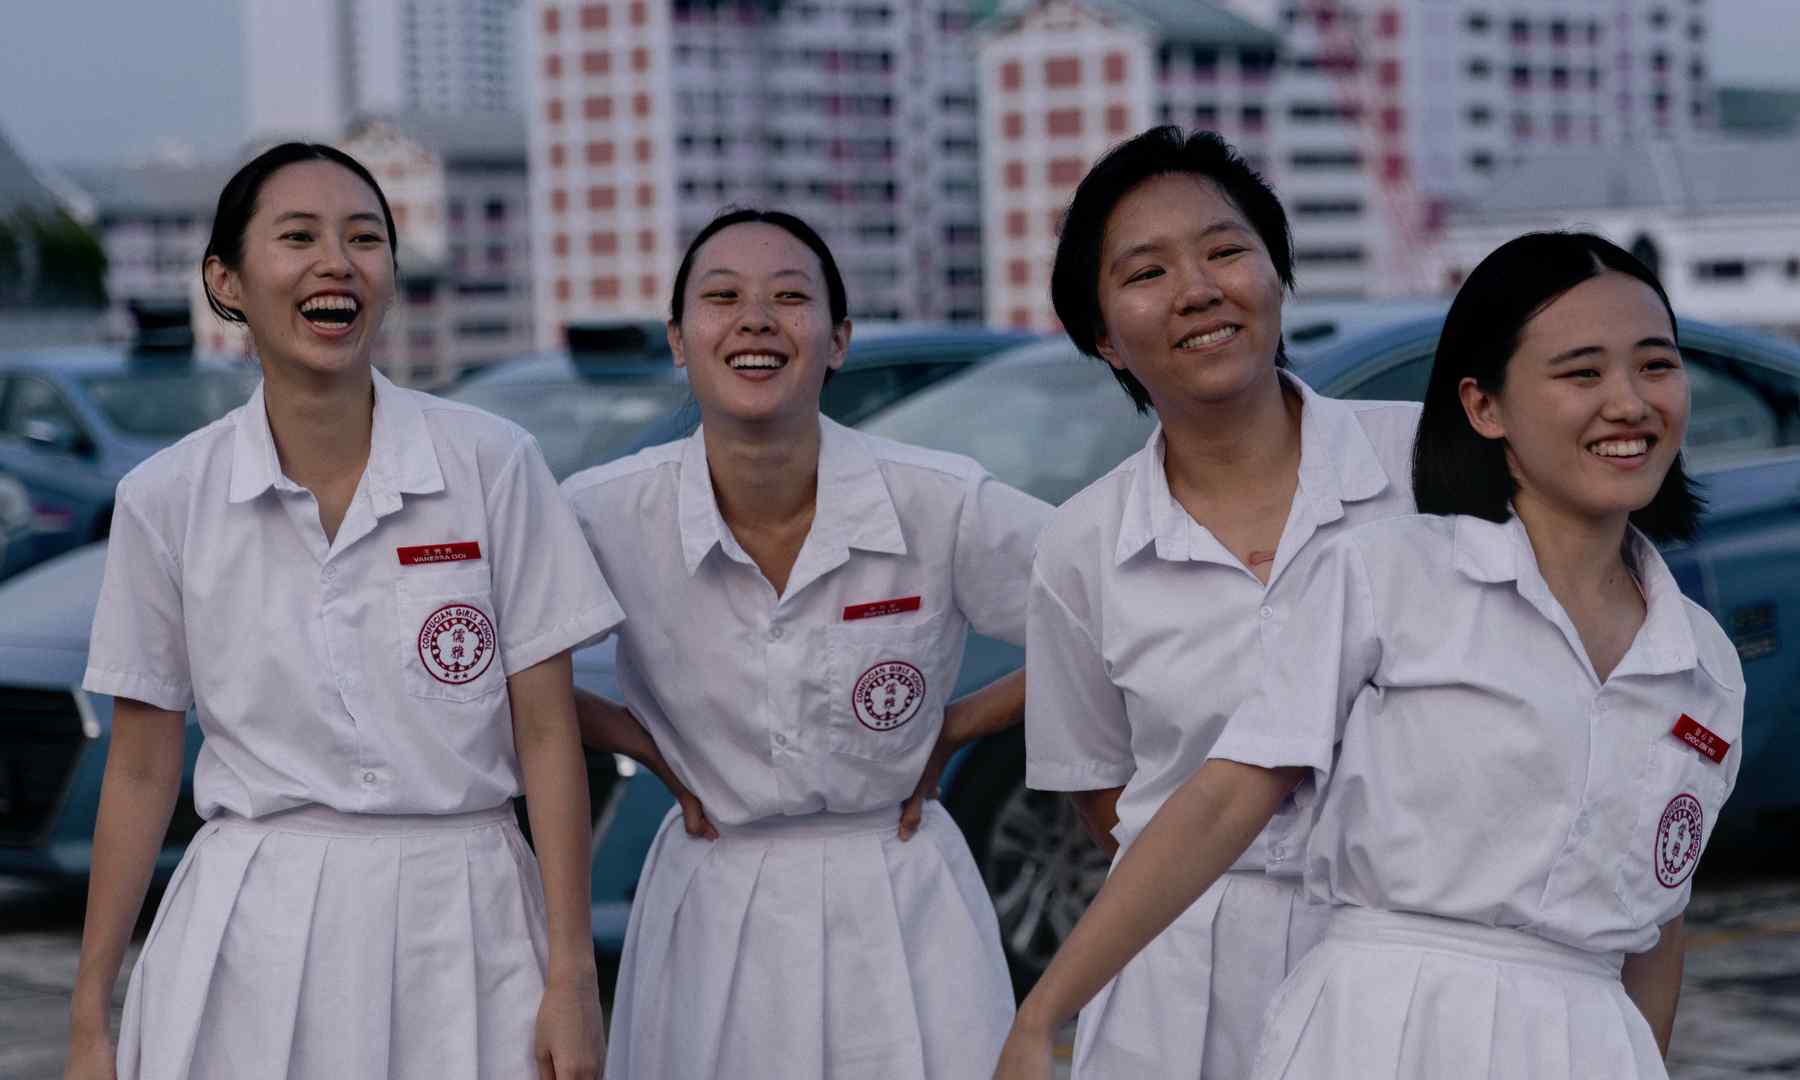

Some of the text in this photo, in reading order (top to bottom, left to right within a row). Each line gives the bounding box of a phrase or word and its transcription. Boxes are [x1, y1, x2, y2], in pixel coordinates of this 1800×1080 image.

[422, 608, 493, 650] CONFUCIAN GIRLS SCHOOL
[856, 667, 886, 703] CONFUCIAN
[888, 664, 910, 676] GIRLS
